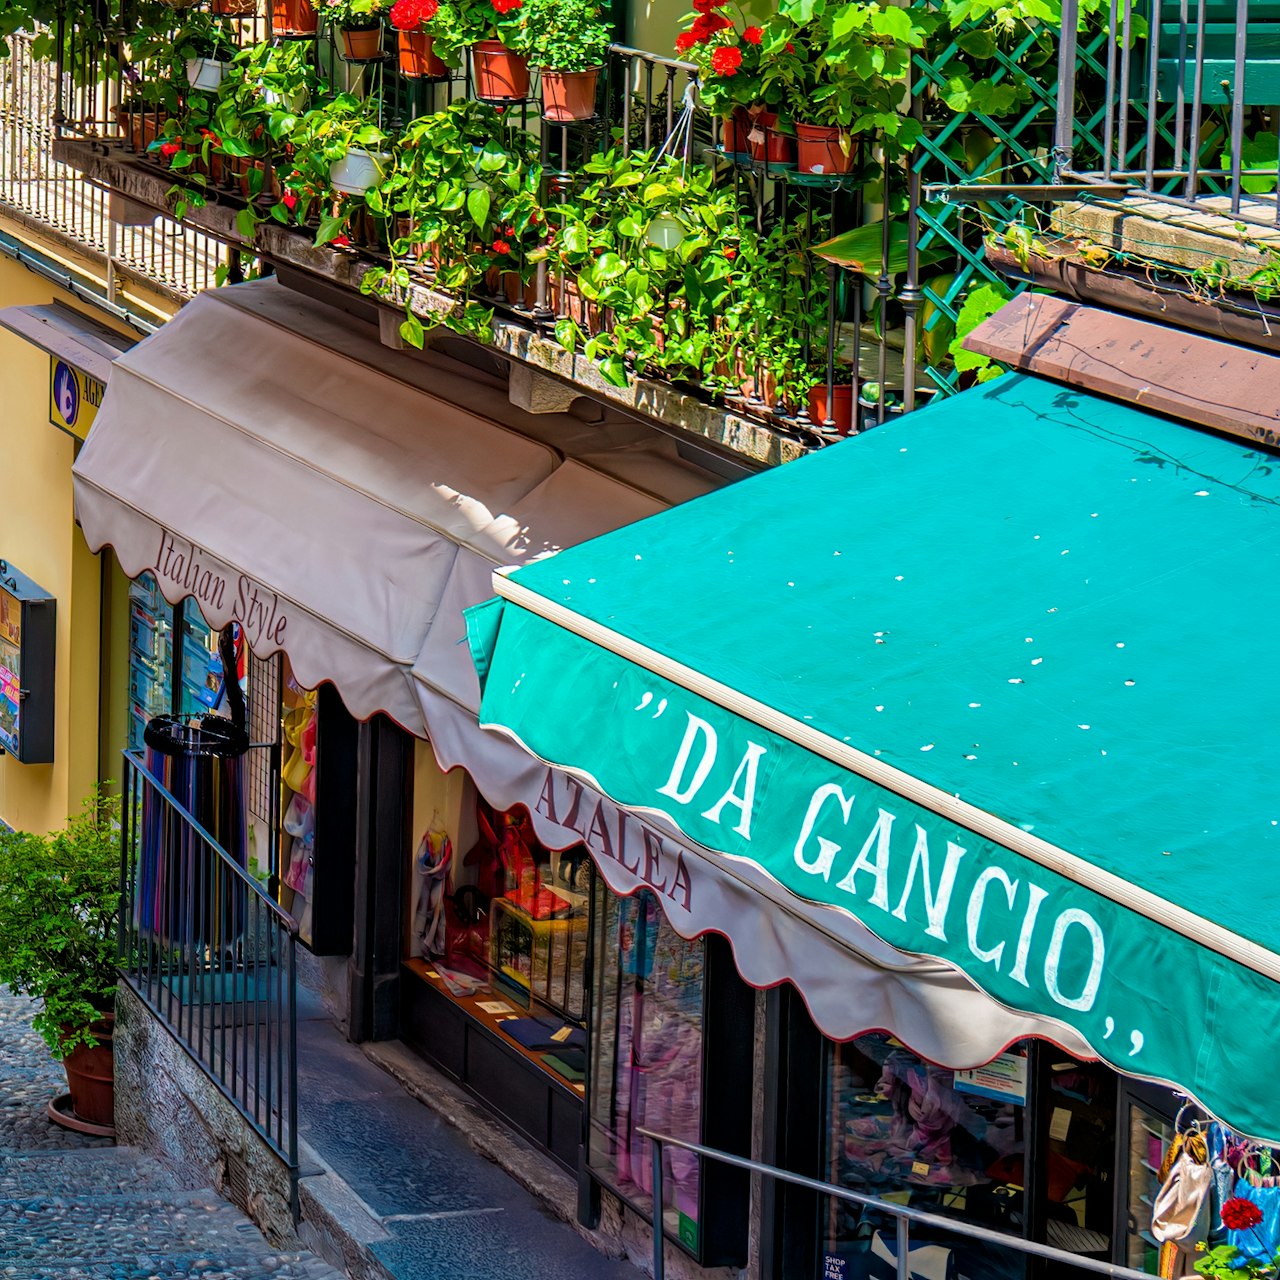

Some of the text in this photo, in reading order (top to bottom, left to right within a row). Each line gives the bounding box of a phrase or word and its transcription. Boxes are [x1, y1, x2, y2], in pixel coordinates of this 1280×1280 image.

[154, 527, 288, 650] Italian Style
[534, 766, 692, 913] AZALEA
[825, 1256, 845, 1266] SHOP
[826, 1263, 840, 1273] TAX
[825, 1271, 843, 1280] FREE
